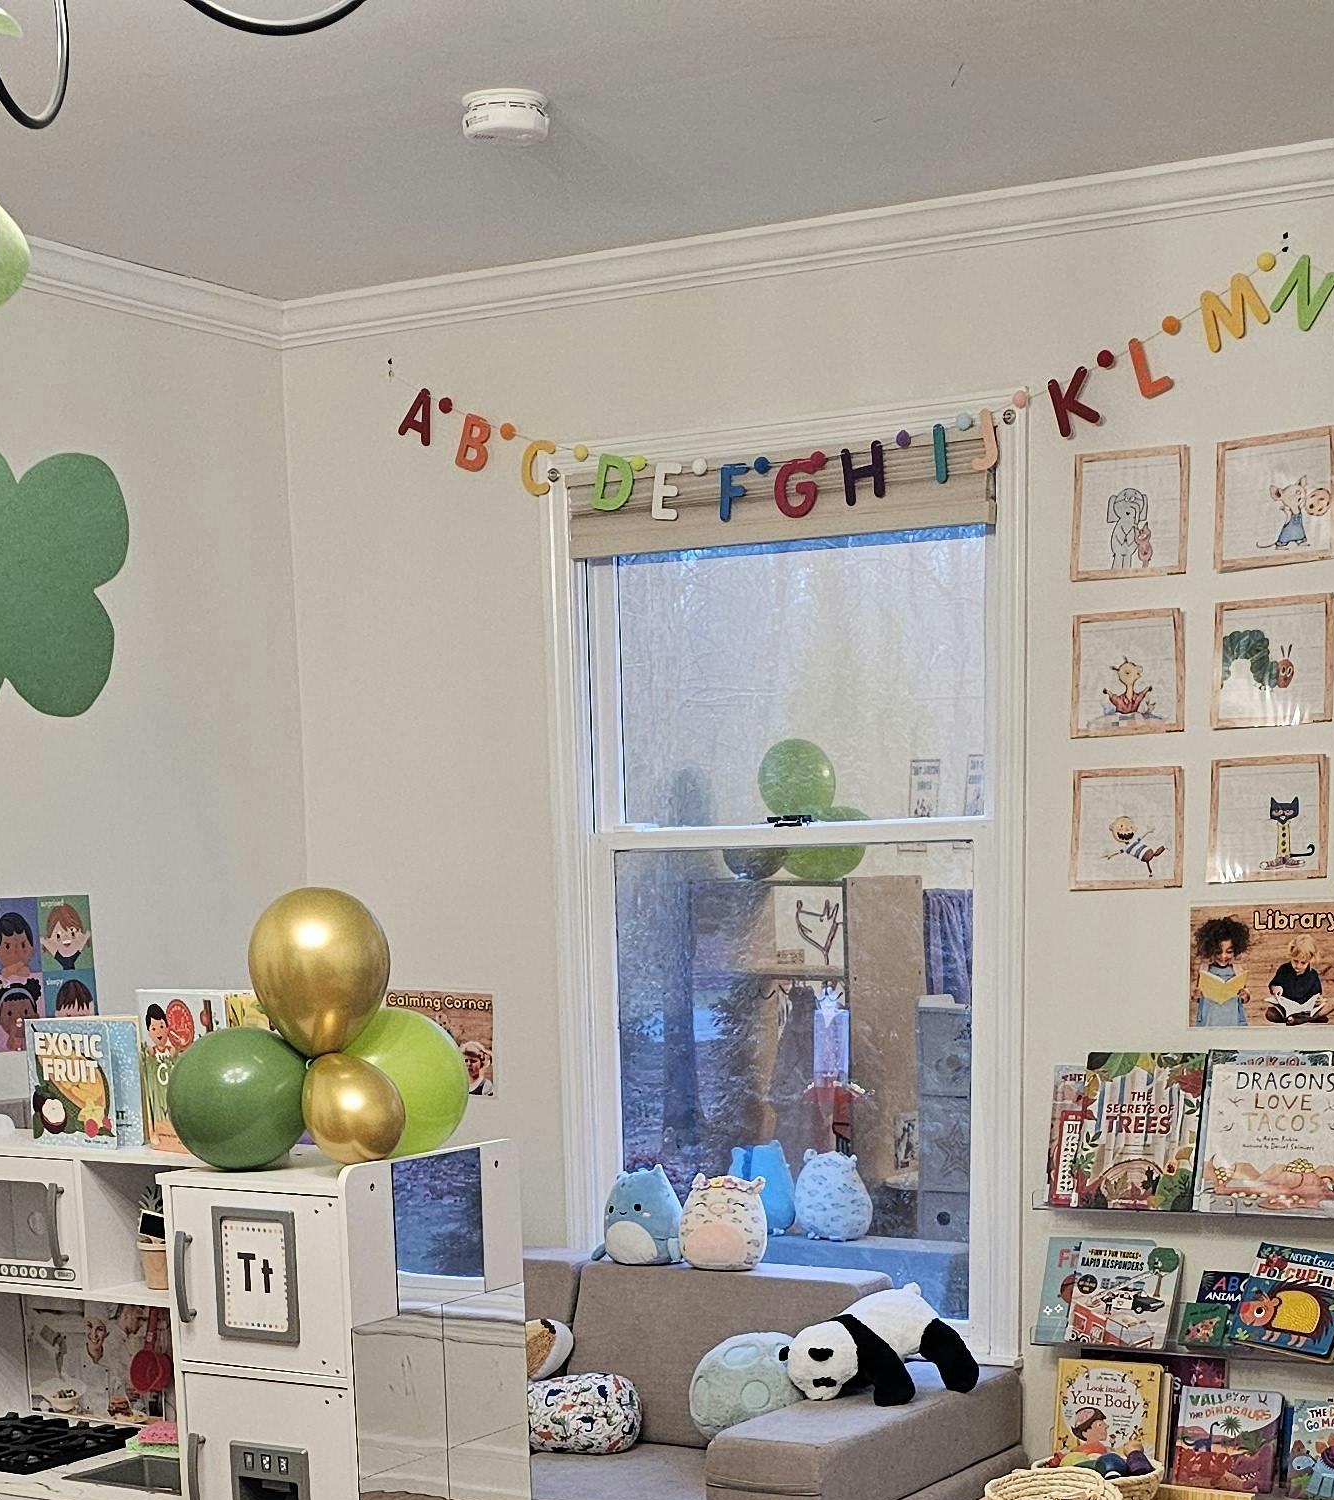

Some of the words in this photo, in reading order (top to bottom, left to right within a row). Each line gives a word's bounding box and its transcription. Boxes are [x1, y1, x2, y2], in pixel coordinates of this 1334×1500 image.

[397, 387, 432, 447] A
[454, 411, 492, 473] B
[521, 439, 557, 498] C
[591, 453, 635, 512] D
[651, 461, 684, 522] E
[718, 462, 750, 523] F
[773, 456, 820, 519] G
[840, 439, 887, 507] H
[971, 408, 999, 472] J
[1047, 366, 1102, 438] K
[1127, 336, 1176, 399] L
[1200, 272, 1272, 354] M
[387, 993, 442, 1011] Calming
[444, 995, 492, 1010] Corner
[34, 1031, 103, 1058] EXOTIC
[41, 1058, 99, 1084] FRUIT
[1131, 1091, 1152, 1101] THE
[1254, 1093, 1312, 1111] LOVE
[1106, 1104, 1155, 1113] SECRETS
[1159, 1105, 1175, 1113] OF
[1106, 1116, 1172, 1134] TREES
[1242, 1112, 1321, 1133] TACOS
[1081, 1257, 1100, 1268] RAPID
[1102, 1258, 1144, 1271] RESPONDERS
[1290, 1252, 1311, 1264] NEVER
[1205, 1292, 1241, 1302] ANIMA
[1086, 1383, 1104, 1392] Look
[1105, 1386, 1127, 1394] inside
[1071, 1390, 1101, 1406] Your
[1104, 1394, 1140, 1414] Body
[1309, 1408, 1327, 1418] THE
